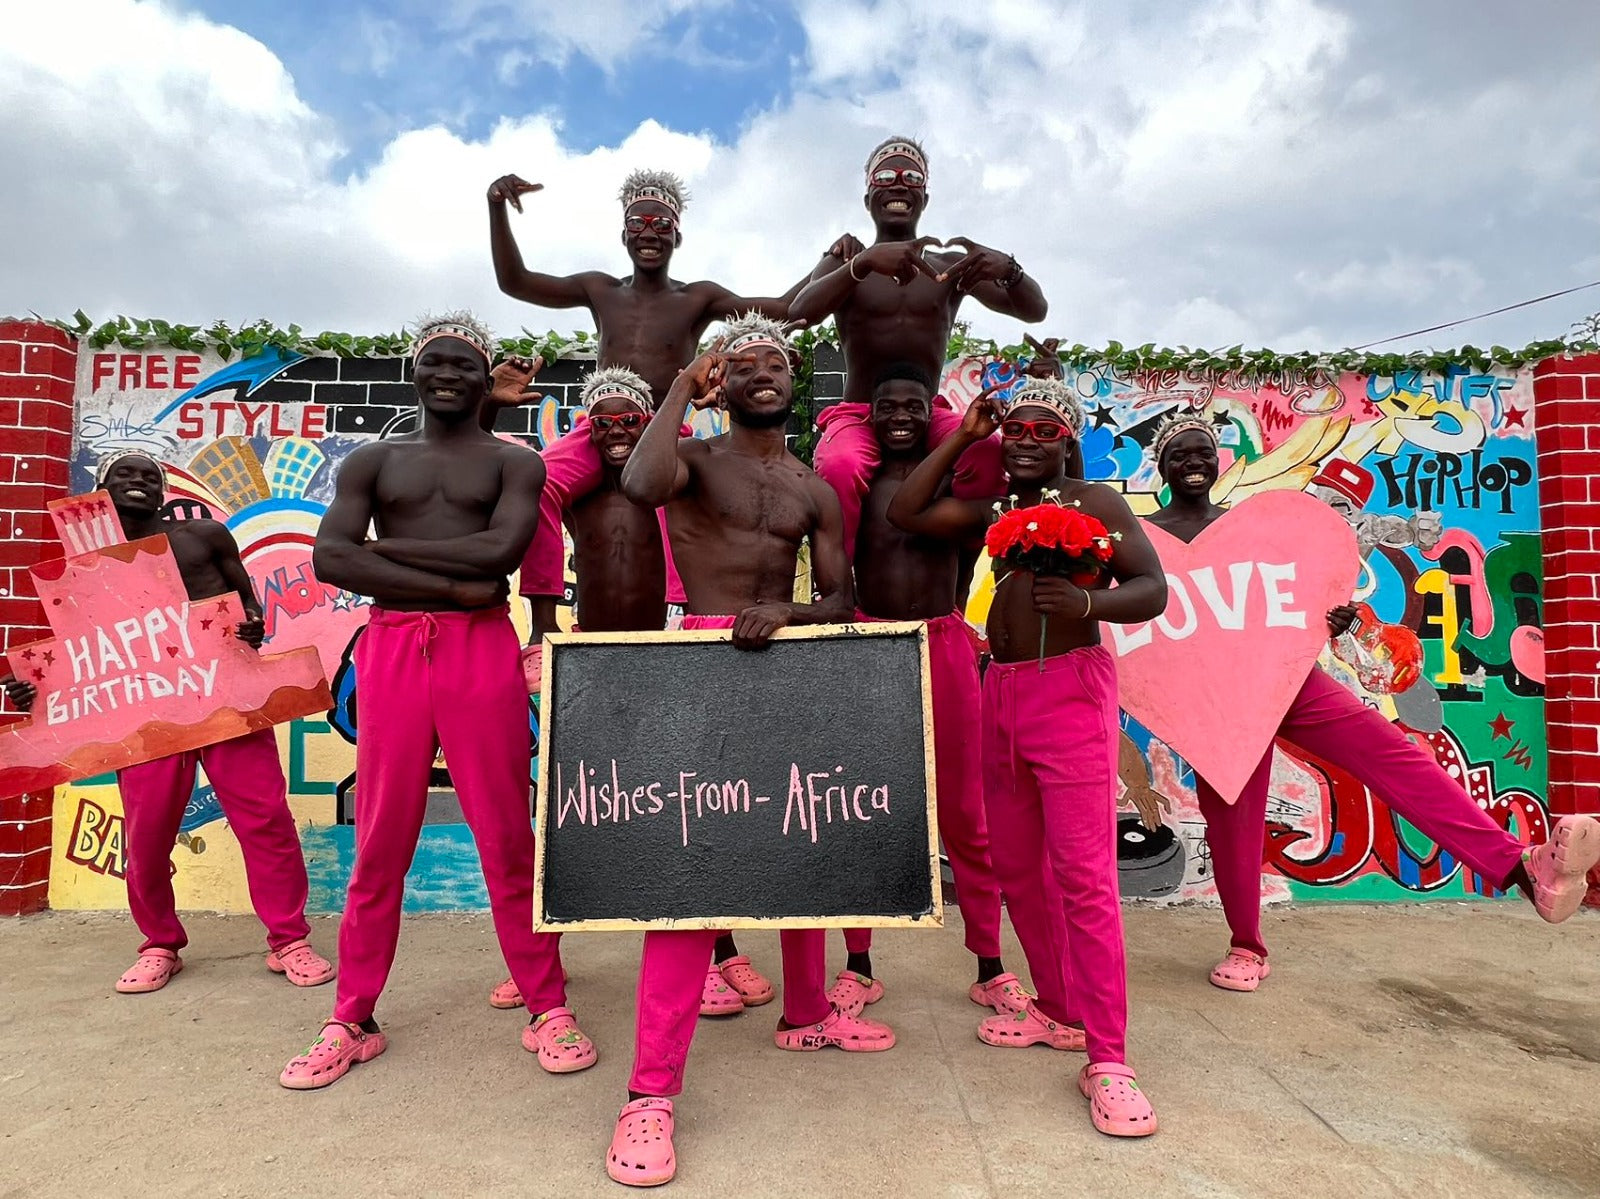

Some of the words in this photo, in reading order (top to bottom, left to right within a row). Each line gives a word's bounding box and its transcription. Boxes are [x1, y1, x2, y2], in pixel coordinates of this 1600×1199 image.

[92, 353, 201, 395] FREE
[176, 402, 326, 439] STYLE
[65, 601, 196, 684] HAPPY
[184, 791, 218, 816] Stree
